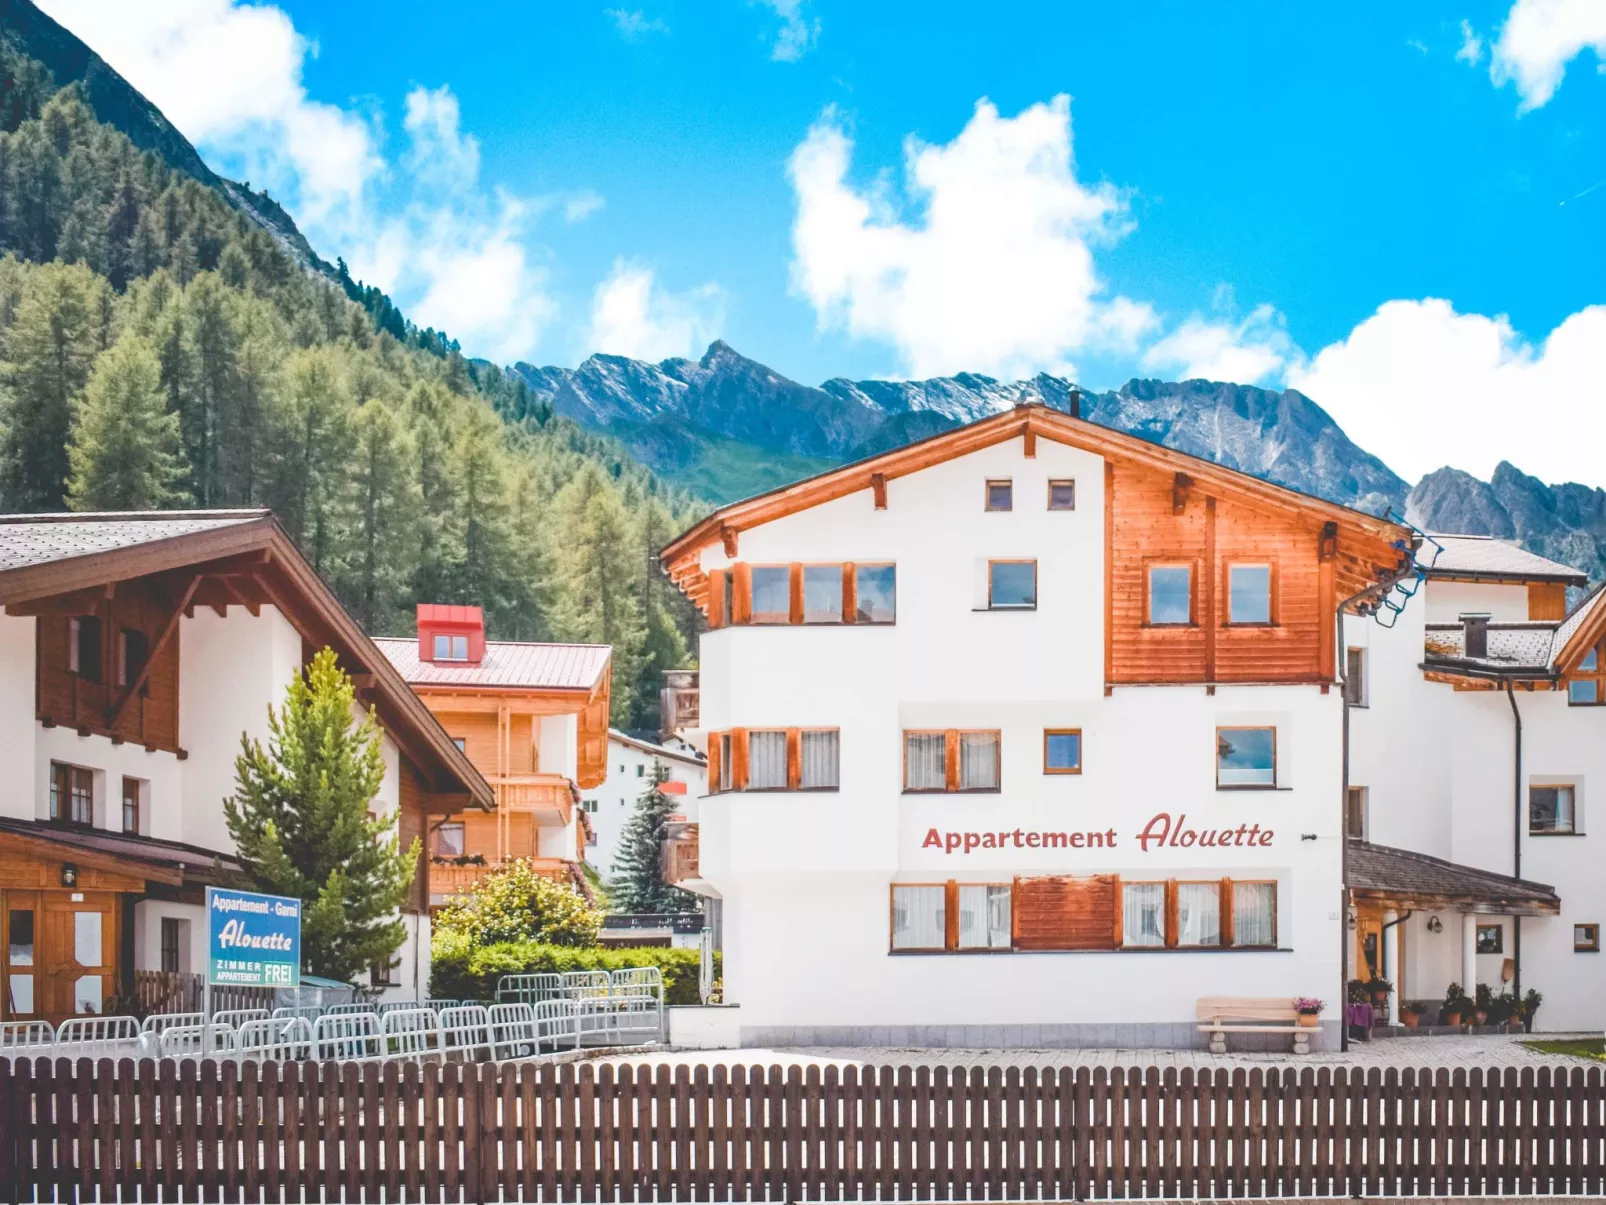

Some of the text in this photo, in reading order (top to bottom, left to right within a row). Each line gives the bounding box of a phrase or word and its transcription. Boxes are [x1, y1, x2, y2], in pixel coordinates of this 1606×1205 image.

[921, 812, 1274, 855] Appartement Alouette
[212, 894, 269, 914] Appartement
[275, 901, 298, 917] Garni
[218, 918, 293, 951] Alouette
[216, 960, 261, 971] ZIMMER
[264, 963, 292, 982] FREI
[216, 972, 261, 982] APPARTEMENT
